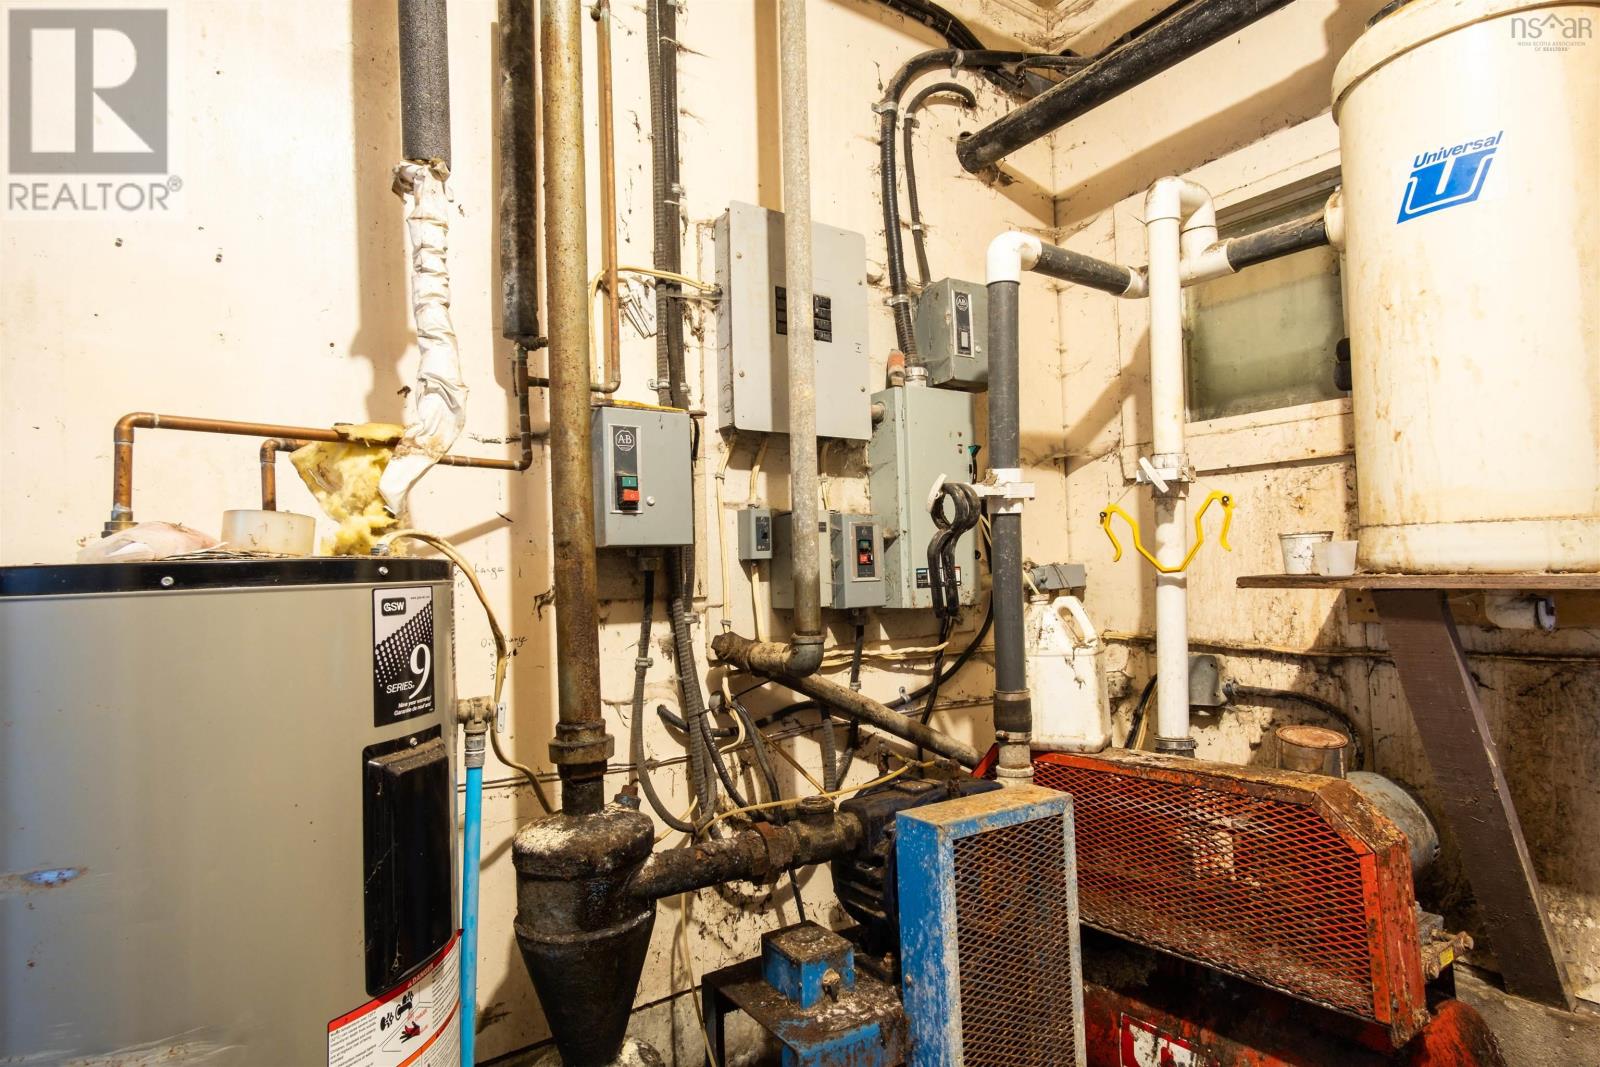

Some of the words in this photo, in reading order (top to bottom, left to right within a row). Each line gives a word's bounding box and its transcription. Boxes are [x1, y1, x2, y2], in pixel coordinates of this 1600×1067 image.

[1413, 130, 1504, 169] Universal
[383, 601, 404, 612] GSW
[386, 681, 413, 694] SERIES
[409, 643, 431, 700] 9
